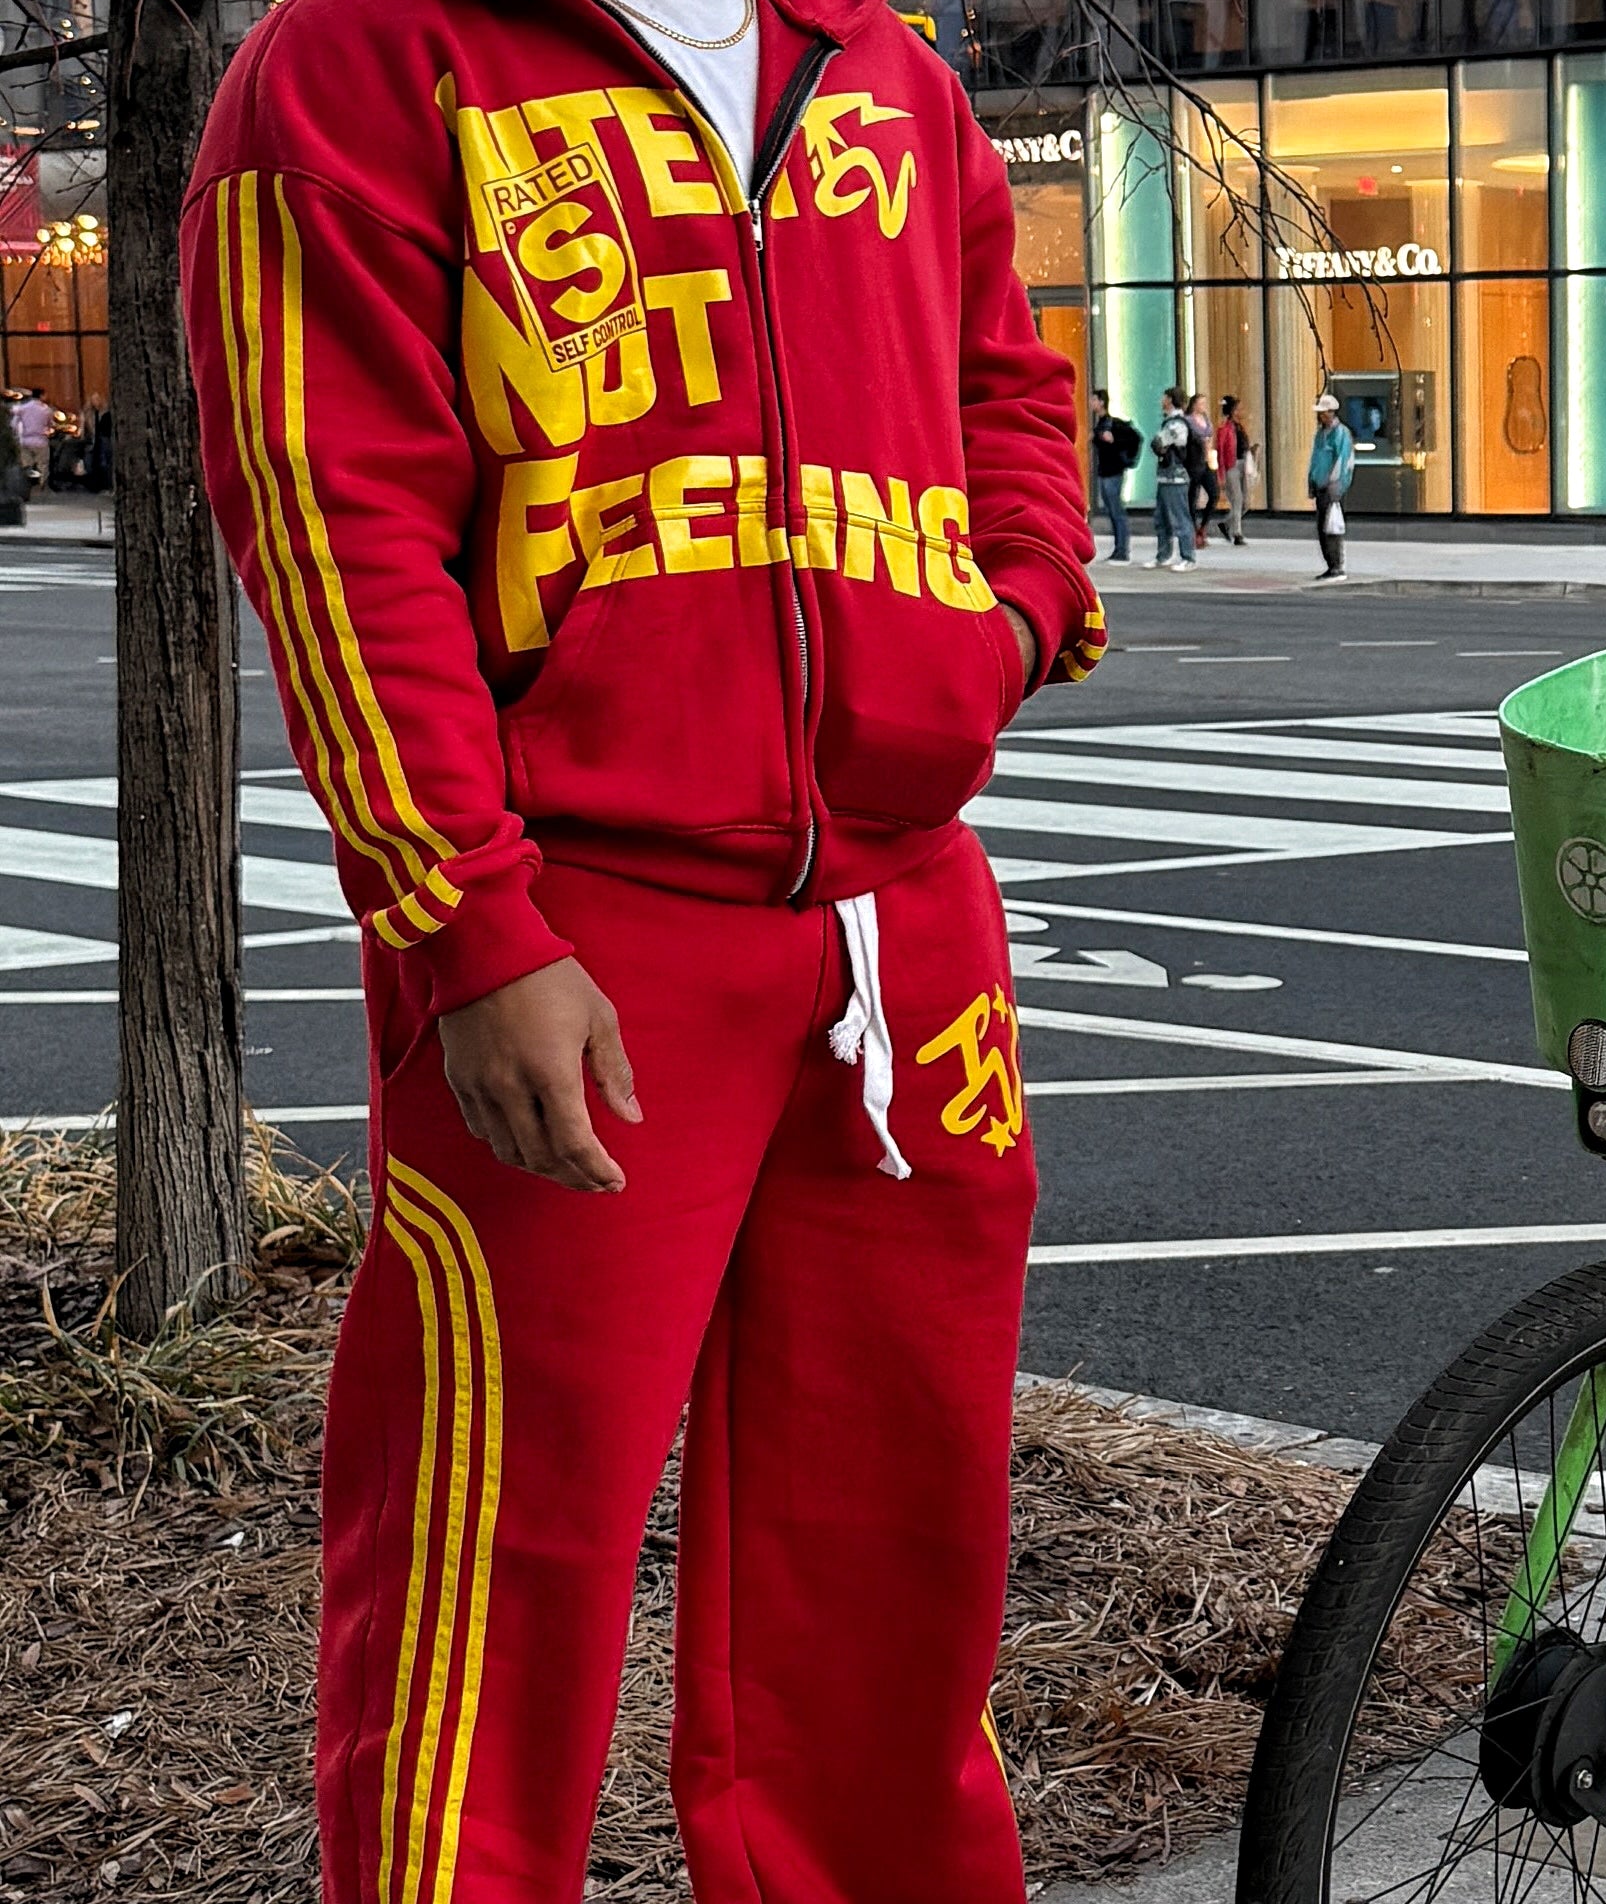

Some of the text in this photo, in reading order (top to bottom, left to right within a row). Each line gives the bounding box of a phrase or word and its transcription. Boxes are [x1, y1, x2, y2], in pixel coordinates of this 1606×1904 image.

[493, 153, 594, 216] RATED
[517, 201, 626, 324] S
[551, 307, 642, 364] SELF CONTROL
